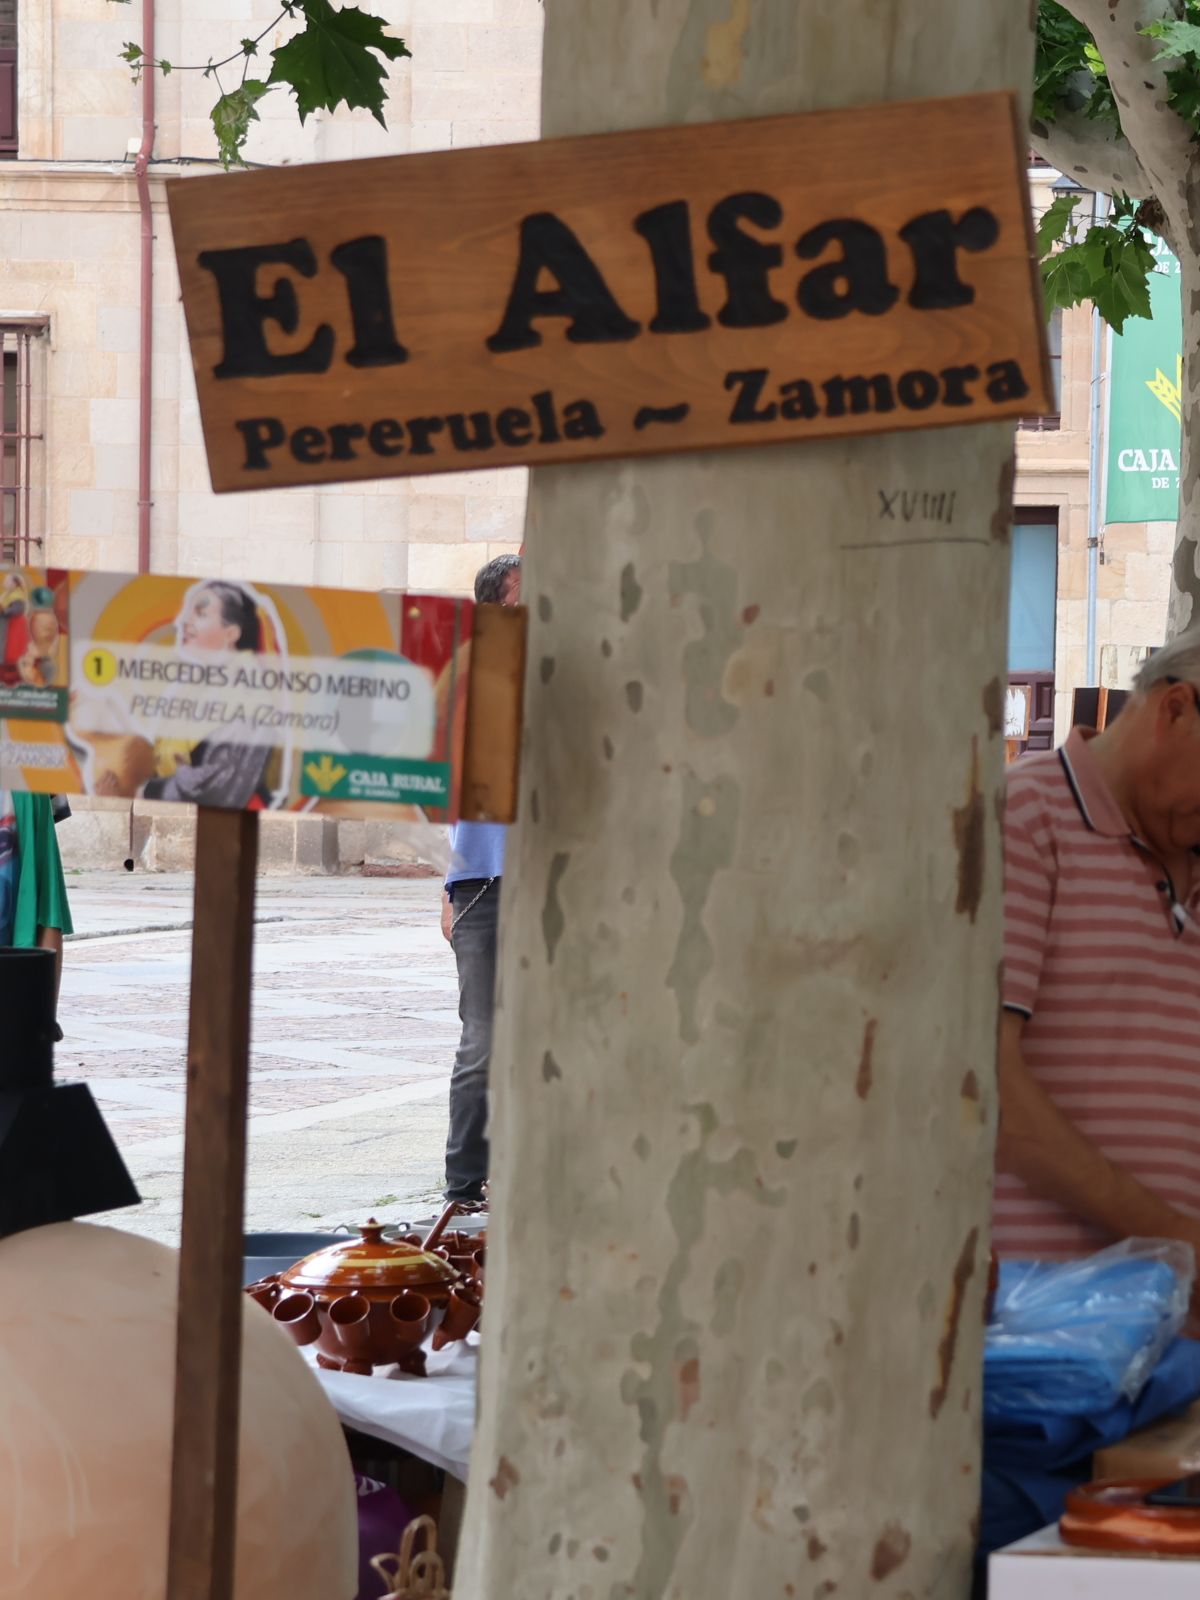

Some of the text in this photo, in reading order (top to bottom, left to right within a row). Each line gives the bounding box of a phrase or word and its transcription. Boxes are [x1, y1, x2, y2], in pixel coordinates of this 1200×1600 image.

[199, 191, 1001, 381] El Alfar
[235, 390, 608, 471] Pereruela
[724, 358, 1032, 426] Zamora
[1117, 448, 1178, 473] CAJA
[1151, 477, 1170, 489] DE
[94, 656, 104, 677] 1
[118, 658, 411, 701] MERCEDES ALONSO MERINO
[130, 694, 340, 734] PERERUELA (Zamora)
[349, 769, 446, 794] CAJA RURAL
